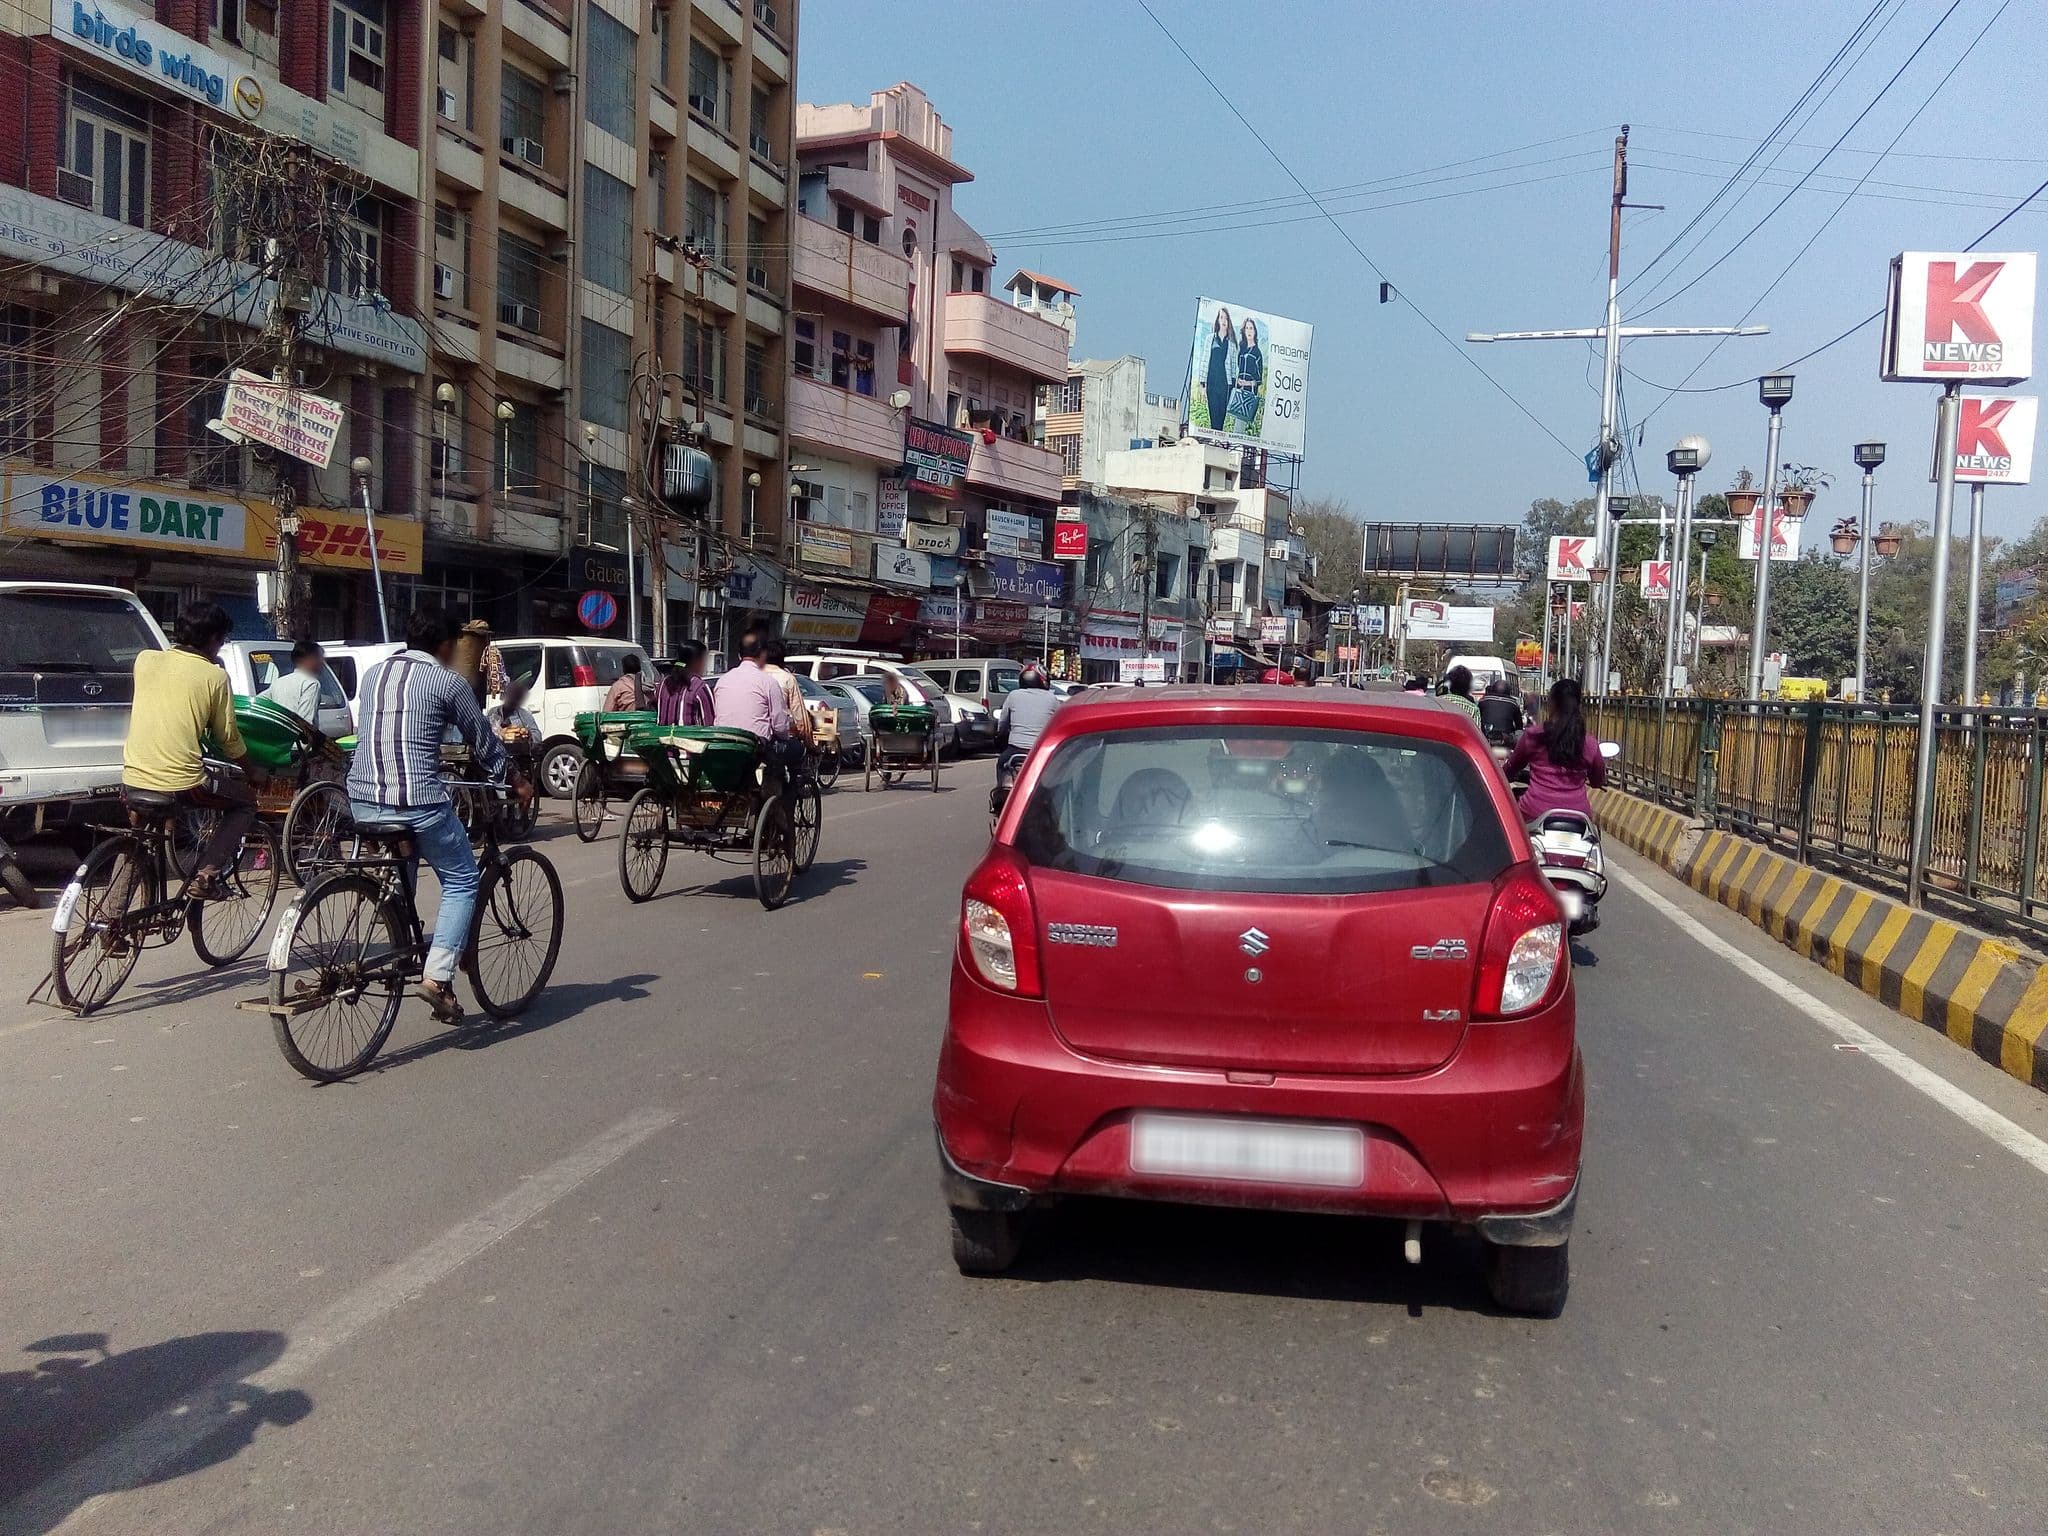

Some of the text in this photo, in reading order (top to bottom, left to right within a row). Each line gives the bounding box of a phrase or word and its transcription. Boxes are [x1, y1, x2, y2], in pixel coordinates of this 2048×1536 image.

[73, 1, 223, 104] birds wing
[1925, 261, 2007, 343] K
[364, 332, 400, 352] SOCIETY
[400, 344, 416, 357] LTD
[1925, 343, 2003, 361] NEWS
[1970, 363, 2002, 372] 24X7
[1274, 369, 1302, 393] Sale
[1957, 399, 2016, 456] K
[1956, 455, 2011, 469] NEWS
[1987, 469, 2010, 478] 24X7
[885, 493, 899, 501] FOR
[41, 484, 224, 542] BLUE DART
[881, 502, 906, 510] OFFICE
[297, 520, 390, 560] DHL
[918, 537, 943, 548] DTDC
[1752, 543, 1788, 553] NWS
[1558, 538, 1586, 568] K
[1557, 567, 1585, 575] NEWS
[1009, 578, 1016, 592] &
[1018, 577, 1034, 595] Ear
[1036, 578, 1062, 599] Clinic
[1047, 922, 1118, 936] MARUTI
[1047, 932, 1118, 948] SUZUKI
[1411, 944, 1469, 960] 800
